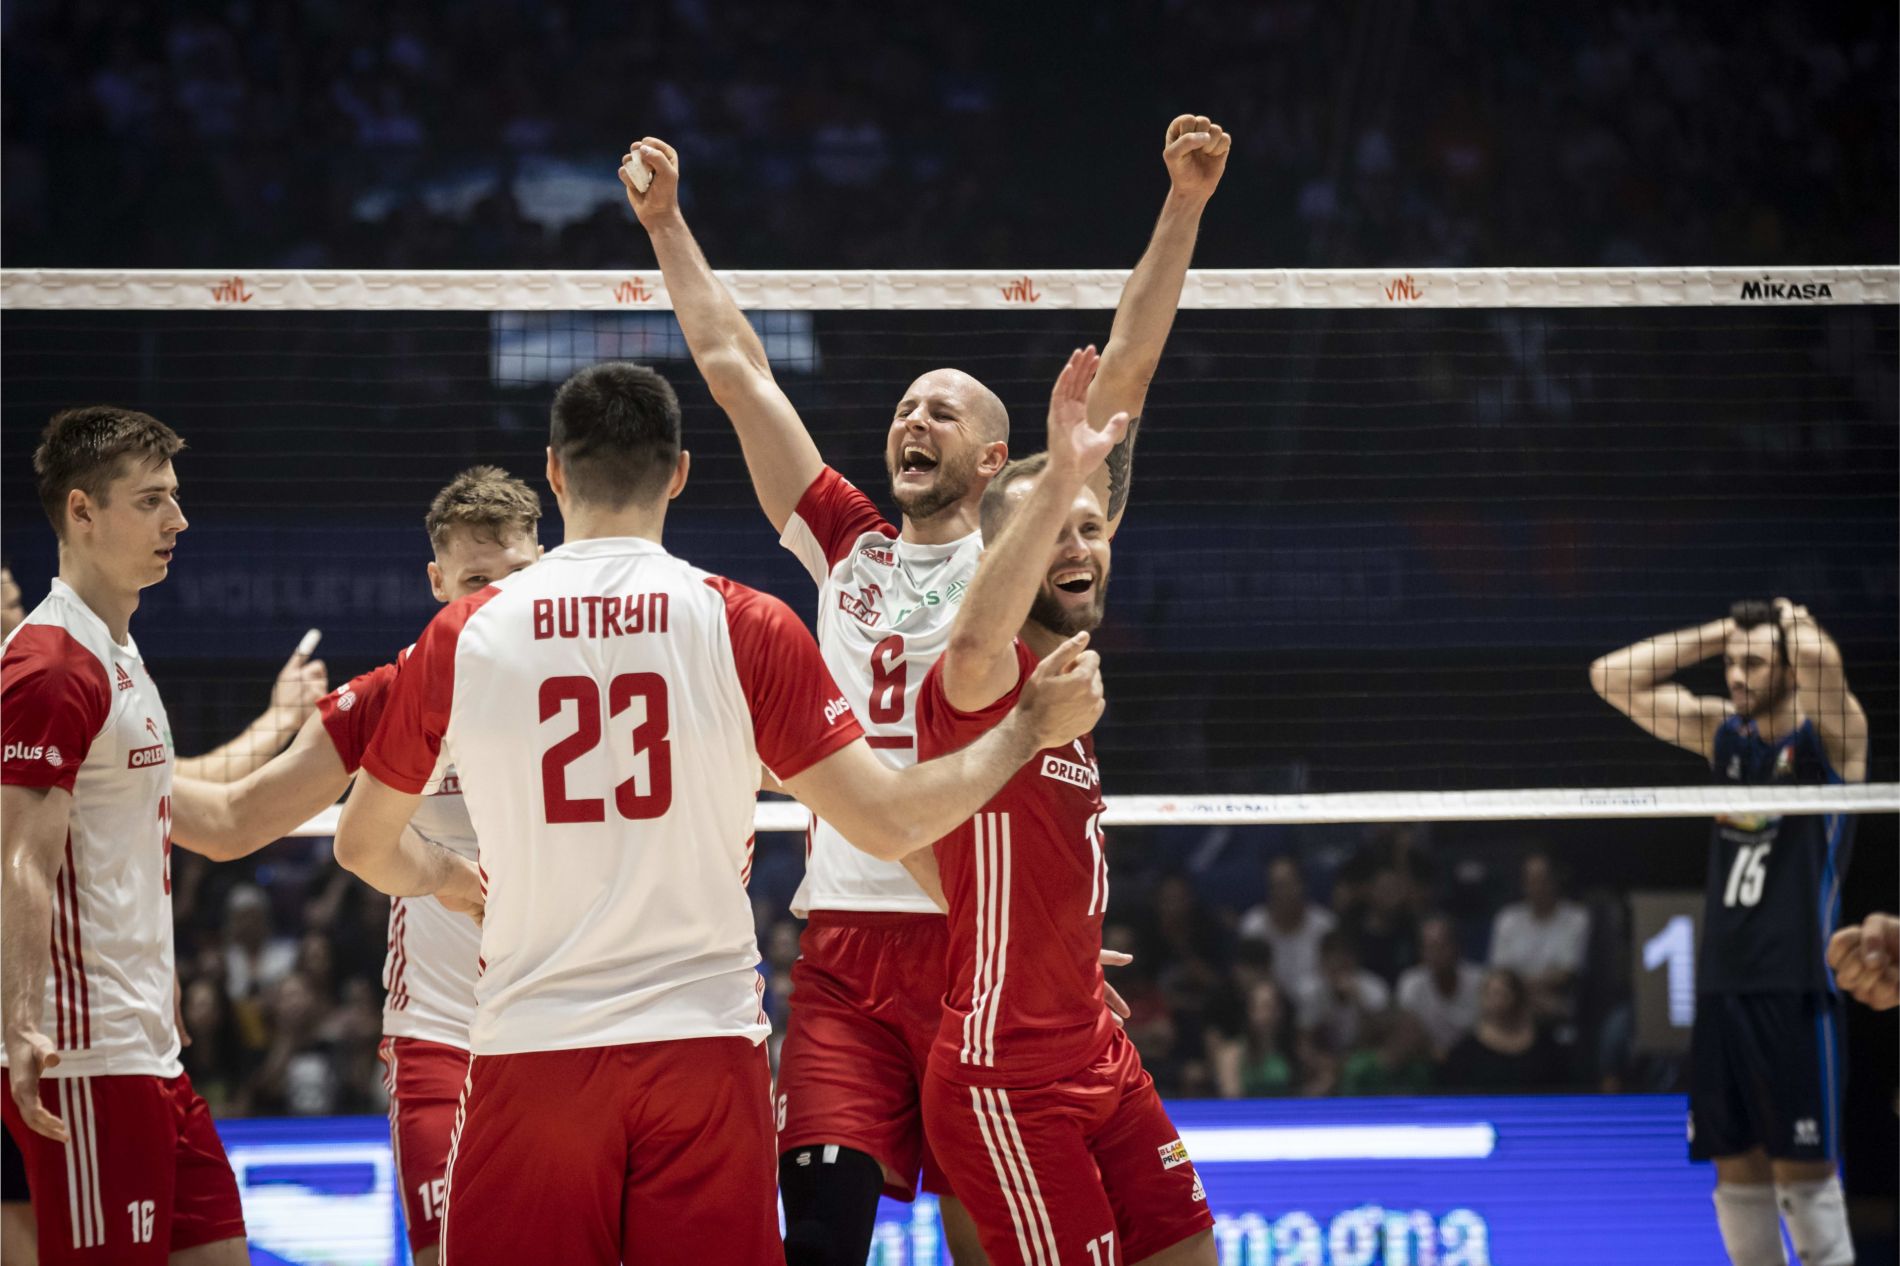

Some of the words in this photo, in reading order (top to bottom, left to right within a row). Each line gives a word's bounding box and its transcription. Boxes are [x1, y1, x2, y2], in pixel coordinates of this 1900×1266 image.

[211, 276, 254, 303] VNL
[613, 276, 653, 303] VNL
[1001, 275, 1042, 303] VNL
[1384, 273, 1424, 301] VNL
[1740, 275, 1833, 300] MIKASA
[533, 592, 669, 640] BUTRYN
[868, 634, 908, 725] 6
[824, 696, 850, 725] plus
[3, 742, 44, 763] plus
[538, 672, 673, 825] 23
[1046, 760, 1090, 786] ORLEN
[1723, 843, 1772, 908] 15
[776, 1093, 788, 1132] 6
[418, 1179, 447, 1221] 15
[127, 1200, 155, 1243] 16
[1086, 1230, 1115, 1266] 17
